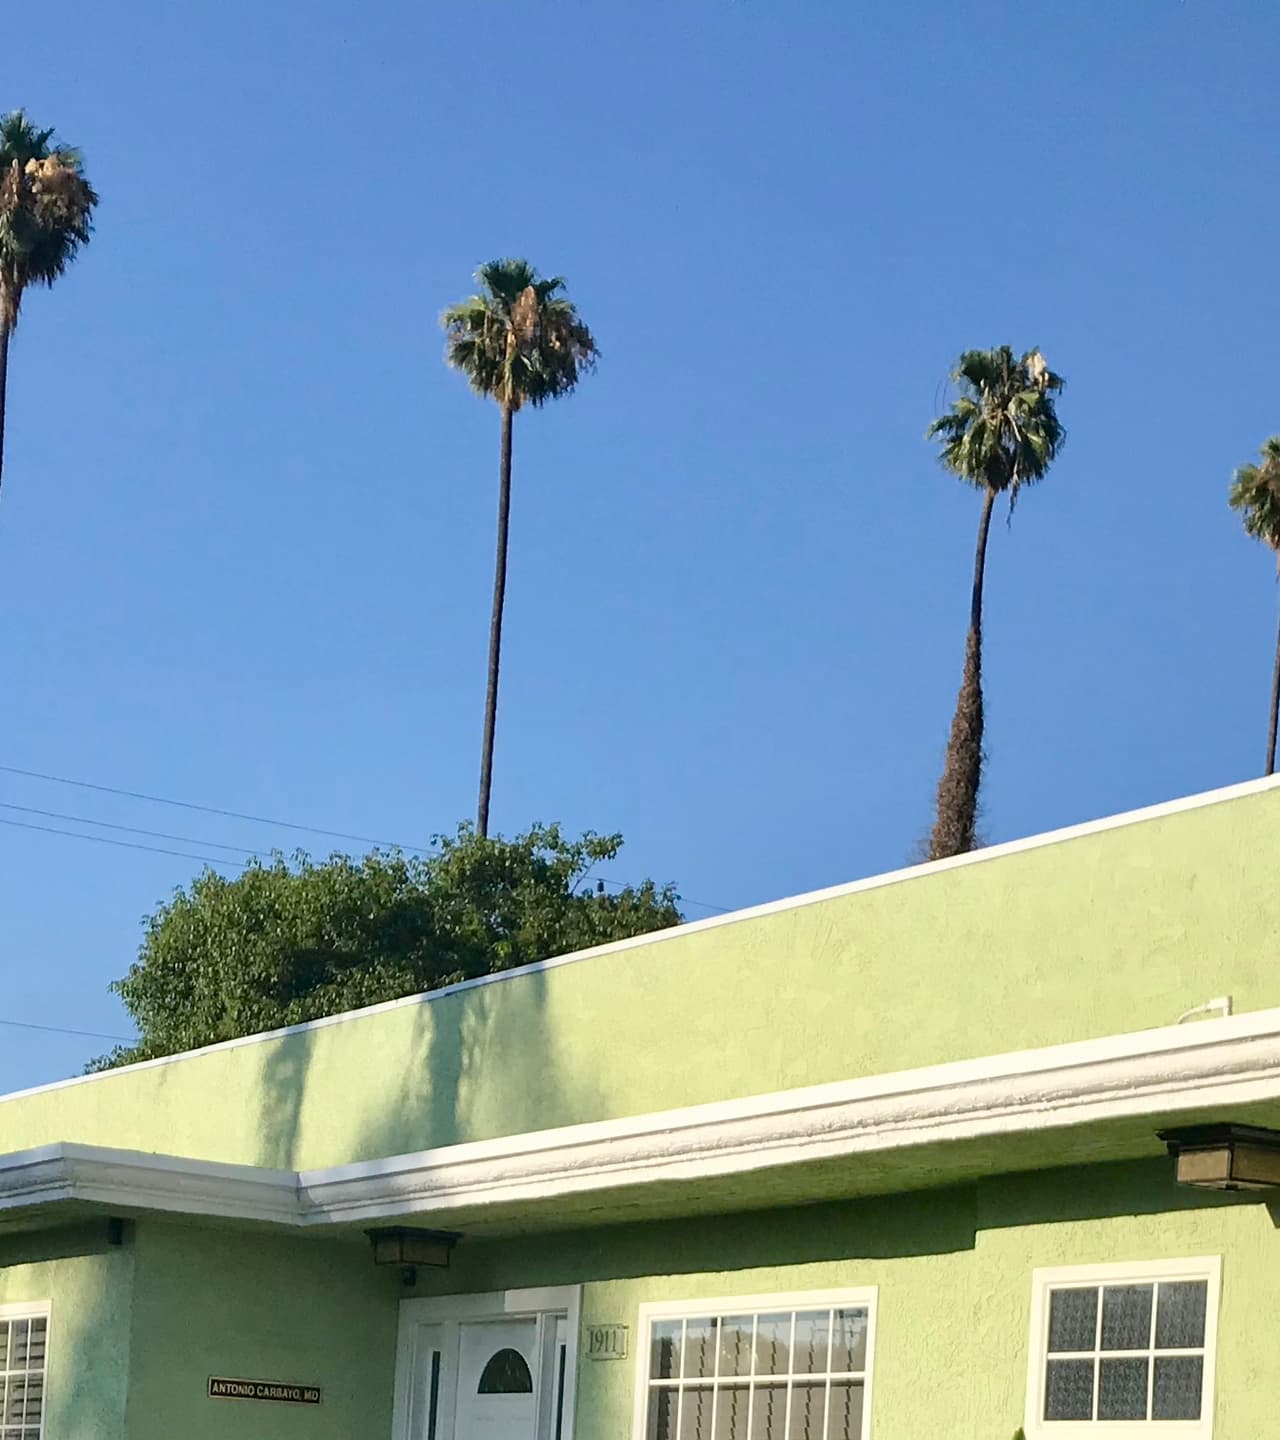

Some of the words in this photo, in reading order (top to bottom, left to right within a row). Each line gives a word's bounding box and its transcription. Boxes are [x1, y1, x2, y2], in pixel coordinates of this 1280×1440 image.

[589, 1328, 616, 1353] 1911
[212, 1382, 255, 1396] ANTONIO
[304, 1389, 319, 1401] MD
